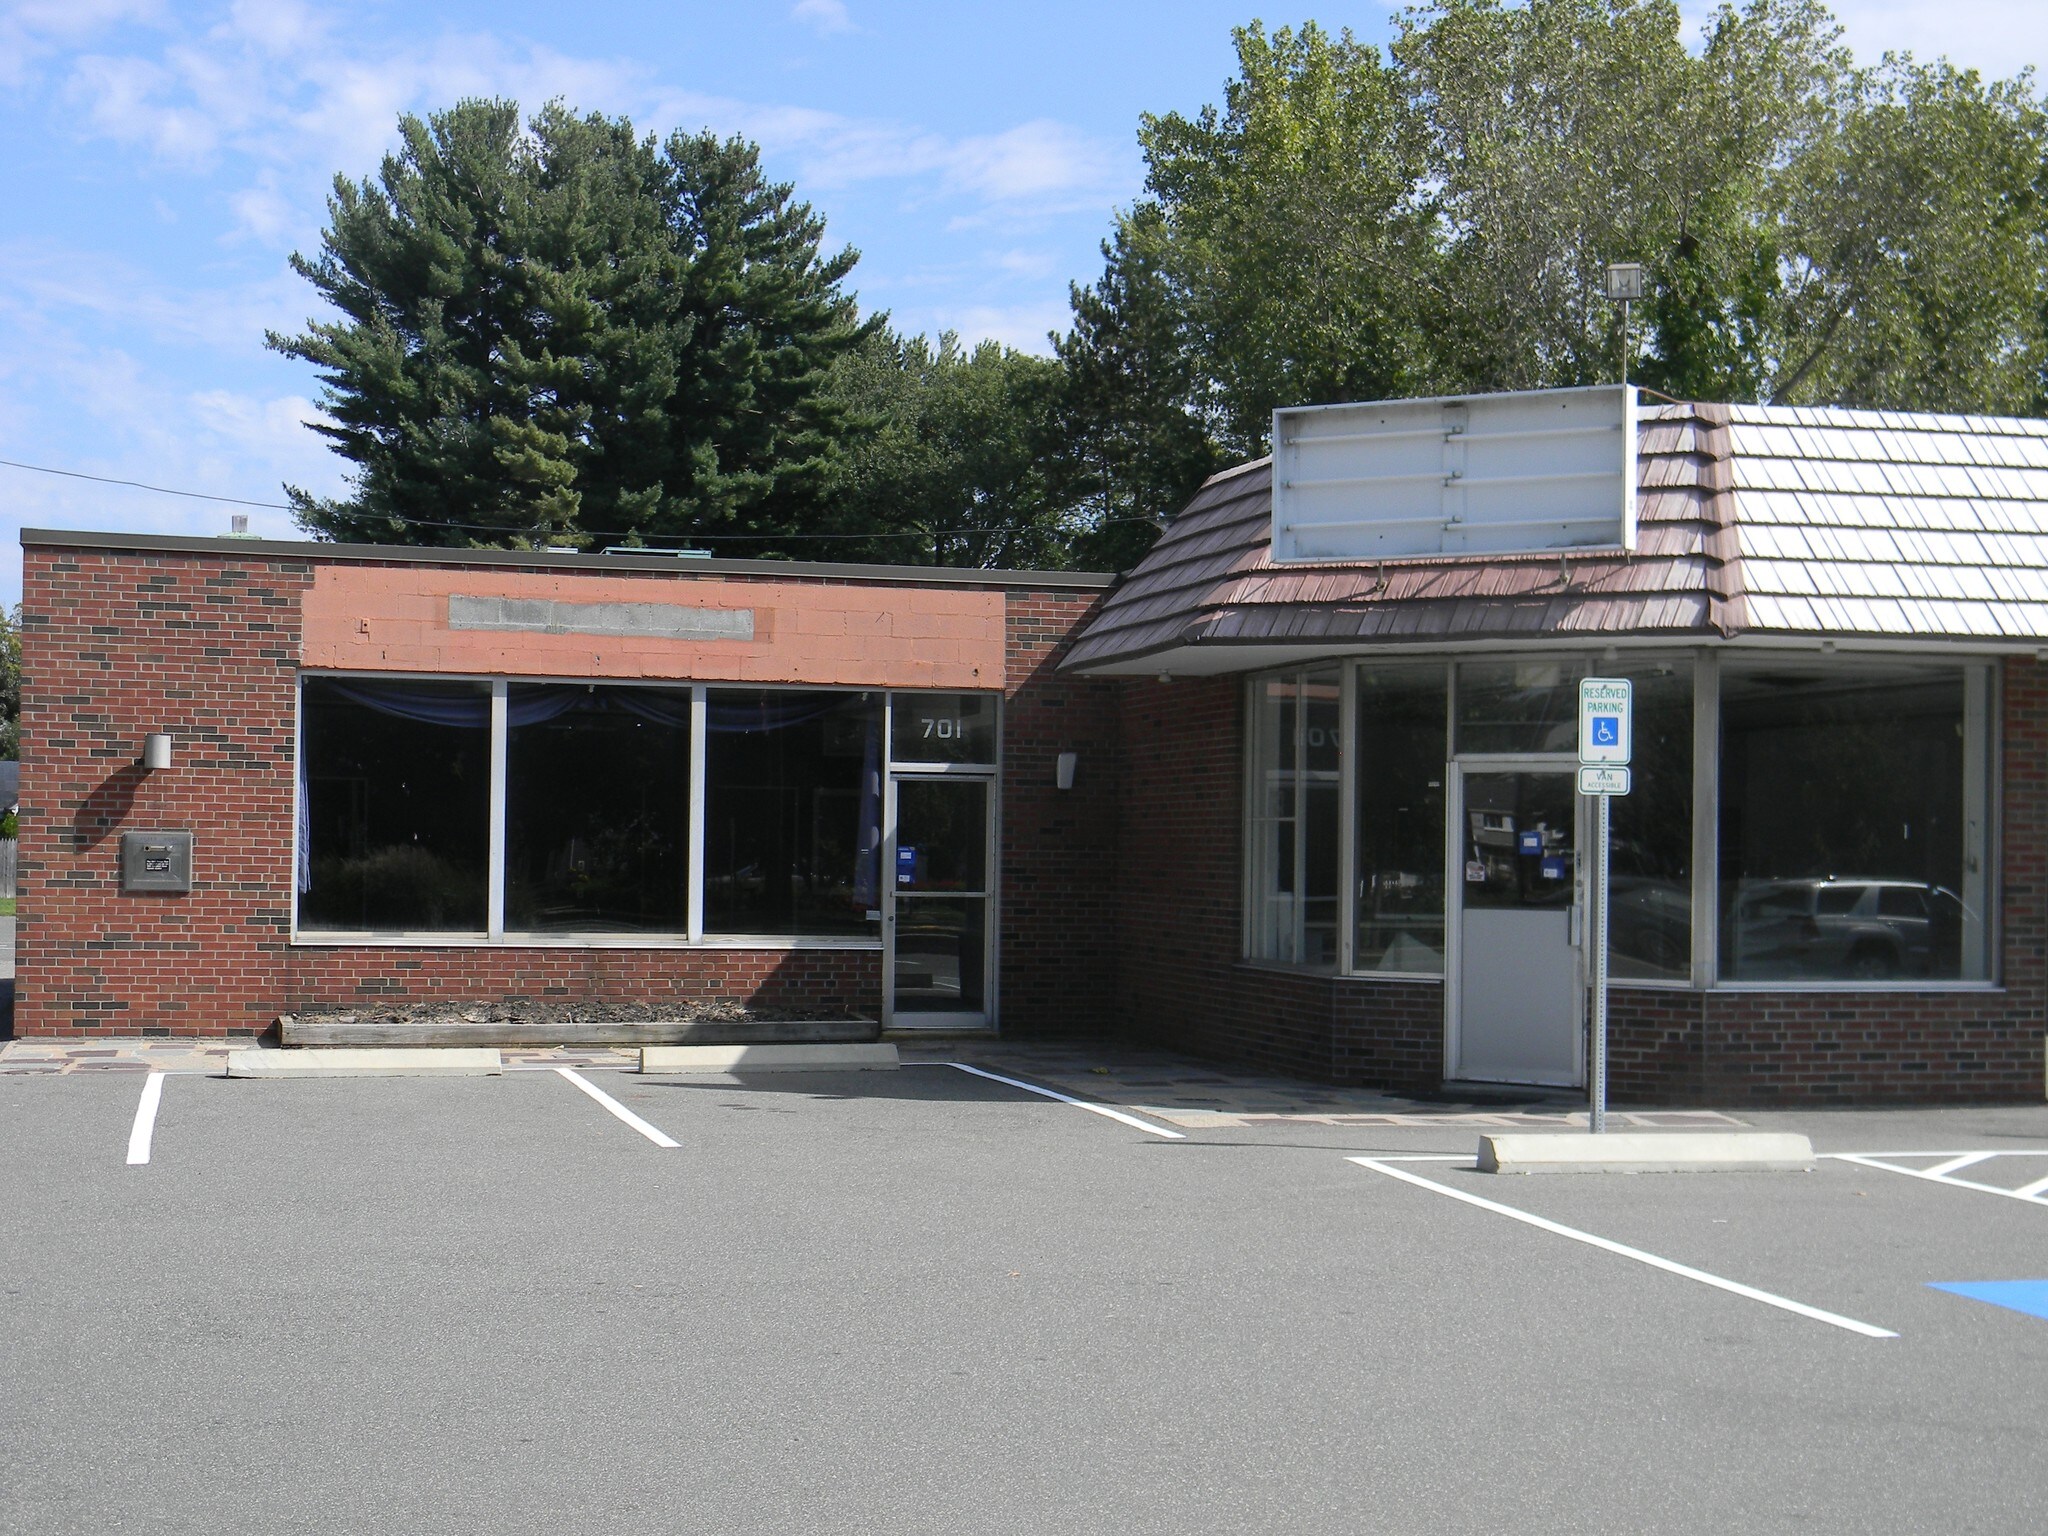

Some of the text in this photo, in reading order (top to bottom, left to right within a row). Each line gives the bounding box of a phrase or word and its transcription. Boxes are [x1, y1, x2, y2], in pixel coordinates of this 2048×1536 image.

[1584, 687, 1627, 699] RESERVED
[1587, 702, 1624, 713] PARKING
[921, 718, 961, 739] 701
[1596, 773, 1613, 782] VAN
[1587, 781, 1622, 789] ACCESSIBLE
